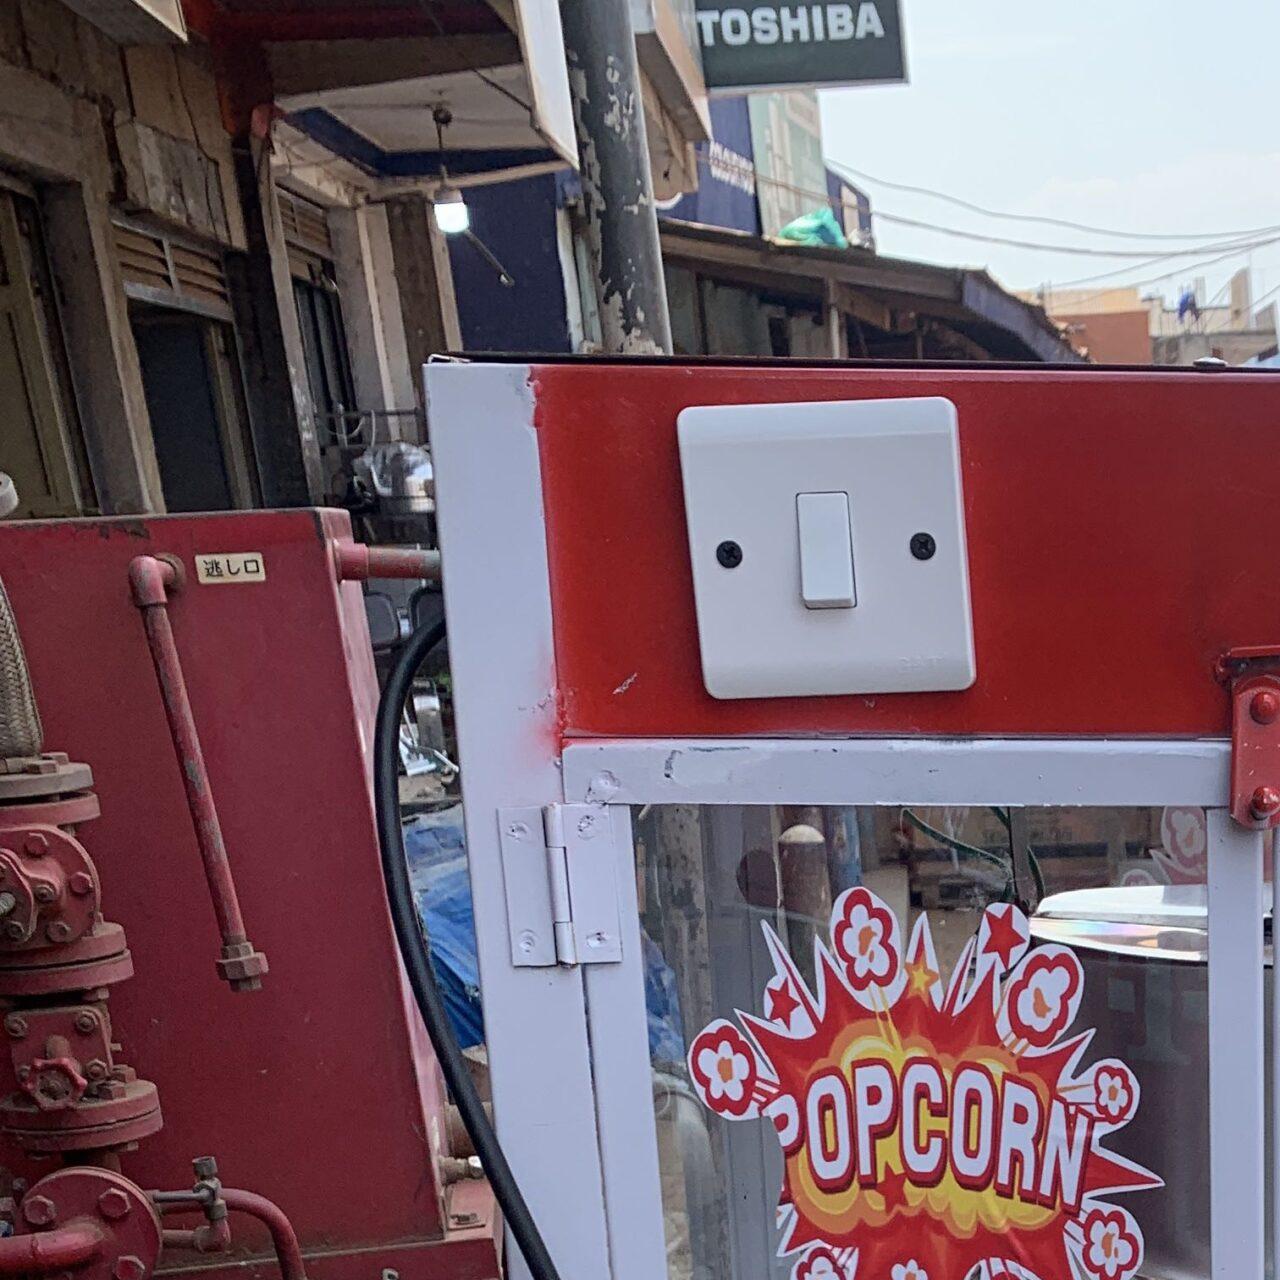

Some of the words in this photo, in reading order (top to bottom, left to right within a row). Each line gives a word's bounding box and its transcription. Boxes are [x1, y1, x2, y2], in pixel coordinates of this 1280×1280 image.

[697, 2, 885, 46] TOSHIBA
[203, 559, 260, 577] 逃し口
